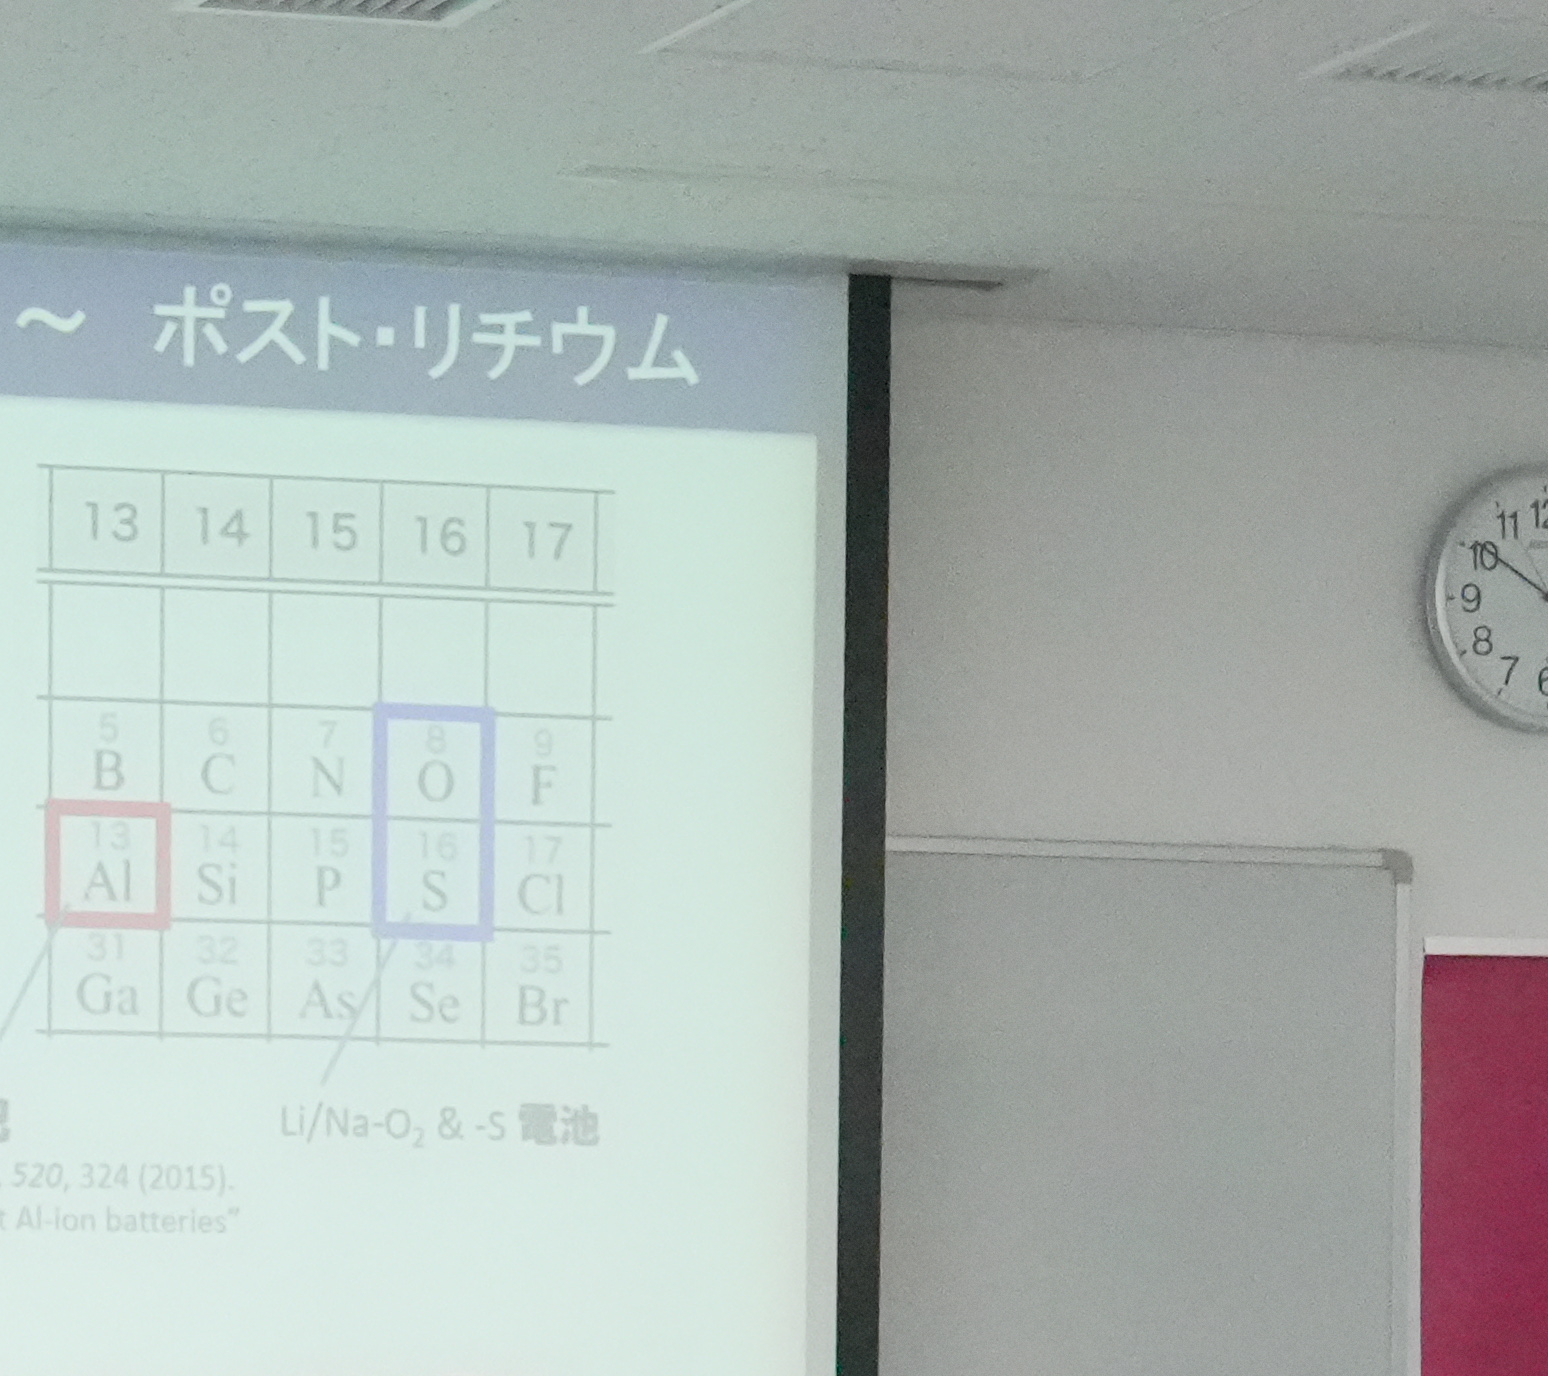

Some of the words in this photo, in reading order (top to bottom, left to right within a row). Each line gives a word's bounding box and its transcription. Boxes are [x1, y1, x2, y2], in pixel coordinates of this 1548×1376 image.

[154, 283, 701, 386] ポスト・リチウム
[85, 501, 139, 542] 13
[196, 506, 250, 546] 14
[306, 511, 359, 551] 15
[415, 516, 467, 556] 16
[523, 520, 574, 561] 17
[1497, 511, 1519, 539] 11
[1470, 541, 1498, 571] 10
[1461, 583, 1481, 612] 9
[1472, 626, 1493, 655] 8
[1501, 656, 1519, 685] 7
[99, 712, 119, 742] 5
[208, 717, 229, 747] 6
[318, 721, 338, 748] 7
[426, 725, 447, 755] 8
[533, 728, 553, 758] 9
[92, 749, 125, 791] B
[200, 752, 236, 796] C
[311, 757, 345, 798] N
[417, 760, 454, 802] O
[530, 764, 558, 806] F
[90, 821, 130, 851] 13
[200, 825, 239, 855] 14
[311, 828, 349, 858] 15
[418, 831, 457, 863] 16
[525, 835, 563, 865] 17
[84, 860, 131, 903] Al
[197, 862, 237, 905] Si
[315, 866, 341, 907] P
[422, 871, 449, 913] S
[517, 873, 564, 917] Cl
[88, 932, 125, 962] 31
[196, 936, 239, 966] 32
[305, 939, 348, 968] 33
[414, 942, 455, 971] 34
[521, 945, 563, 974] 35
[76, 973, 139, 1017] Ga
[186, 976, 248, 1019] Ge
[298, 979, 357, 1021] As
[410, 982, 461, 1025] Se
[517, 985, 570, 1028] Br
[437, 1105, 464, 1141] &
[11, 1162, 71, 1192] 520,
[80, 1163, 129, 1190] 324
